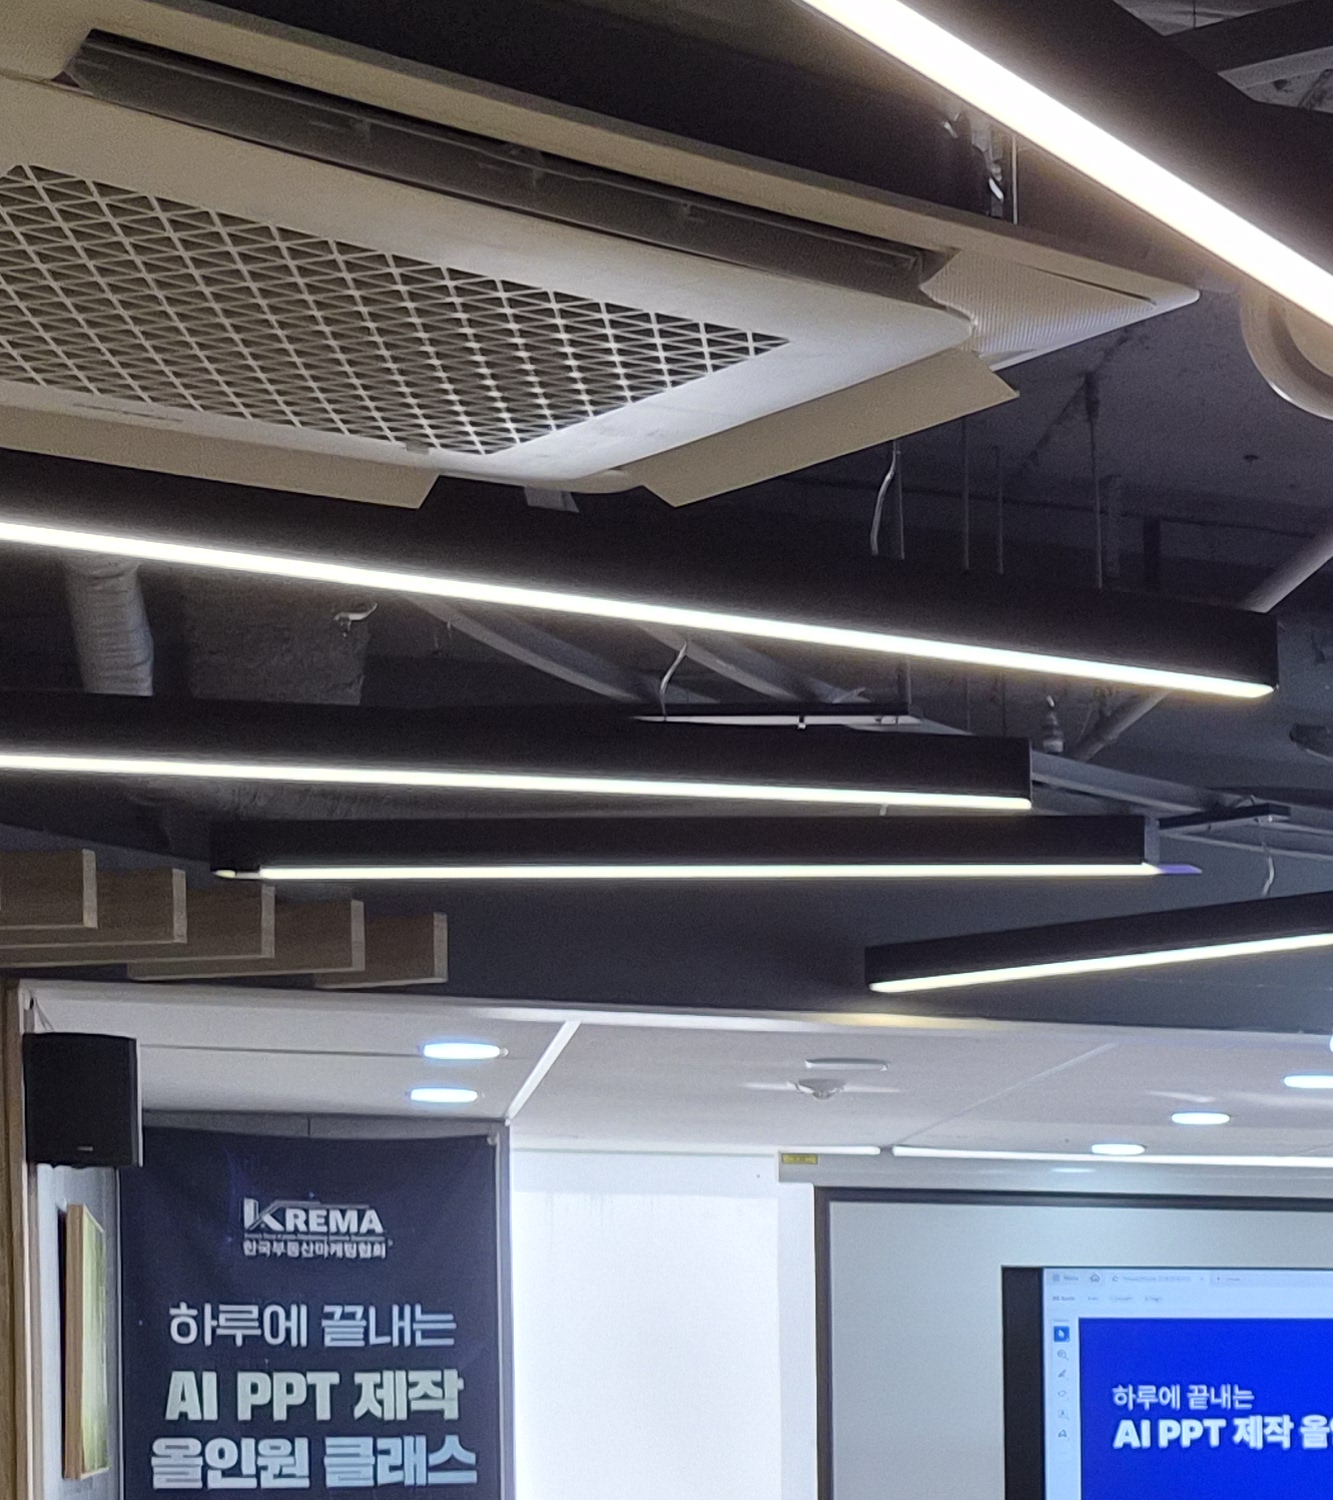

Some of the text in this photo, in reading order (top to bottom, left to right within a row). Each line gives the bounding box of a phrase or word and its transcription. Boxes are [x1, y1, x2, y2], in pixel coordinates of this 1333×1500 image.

[243, 1197, 384, 1234] KREMA
[169, 1302, 457, 1348] 하루에 끝내는
[165, 1368, 465, 1422] AI PPT 제작
[1111, 1384, 1255, 1411] 하루에 끝내는
[1112, 1418, 1151, 1449] AI
[1158, 1418, 1227, 1449] PPT
[1232, 1414, 1295, 1450] 제작
[151, 1434, 478, 1490] 올인원 클래스
